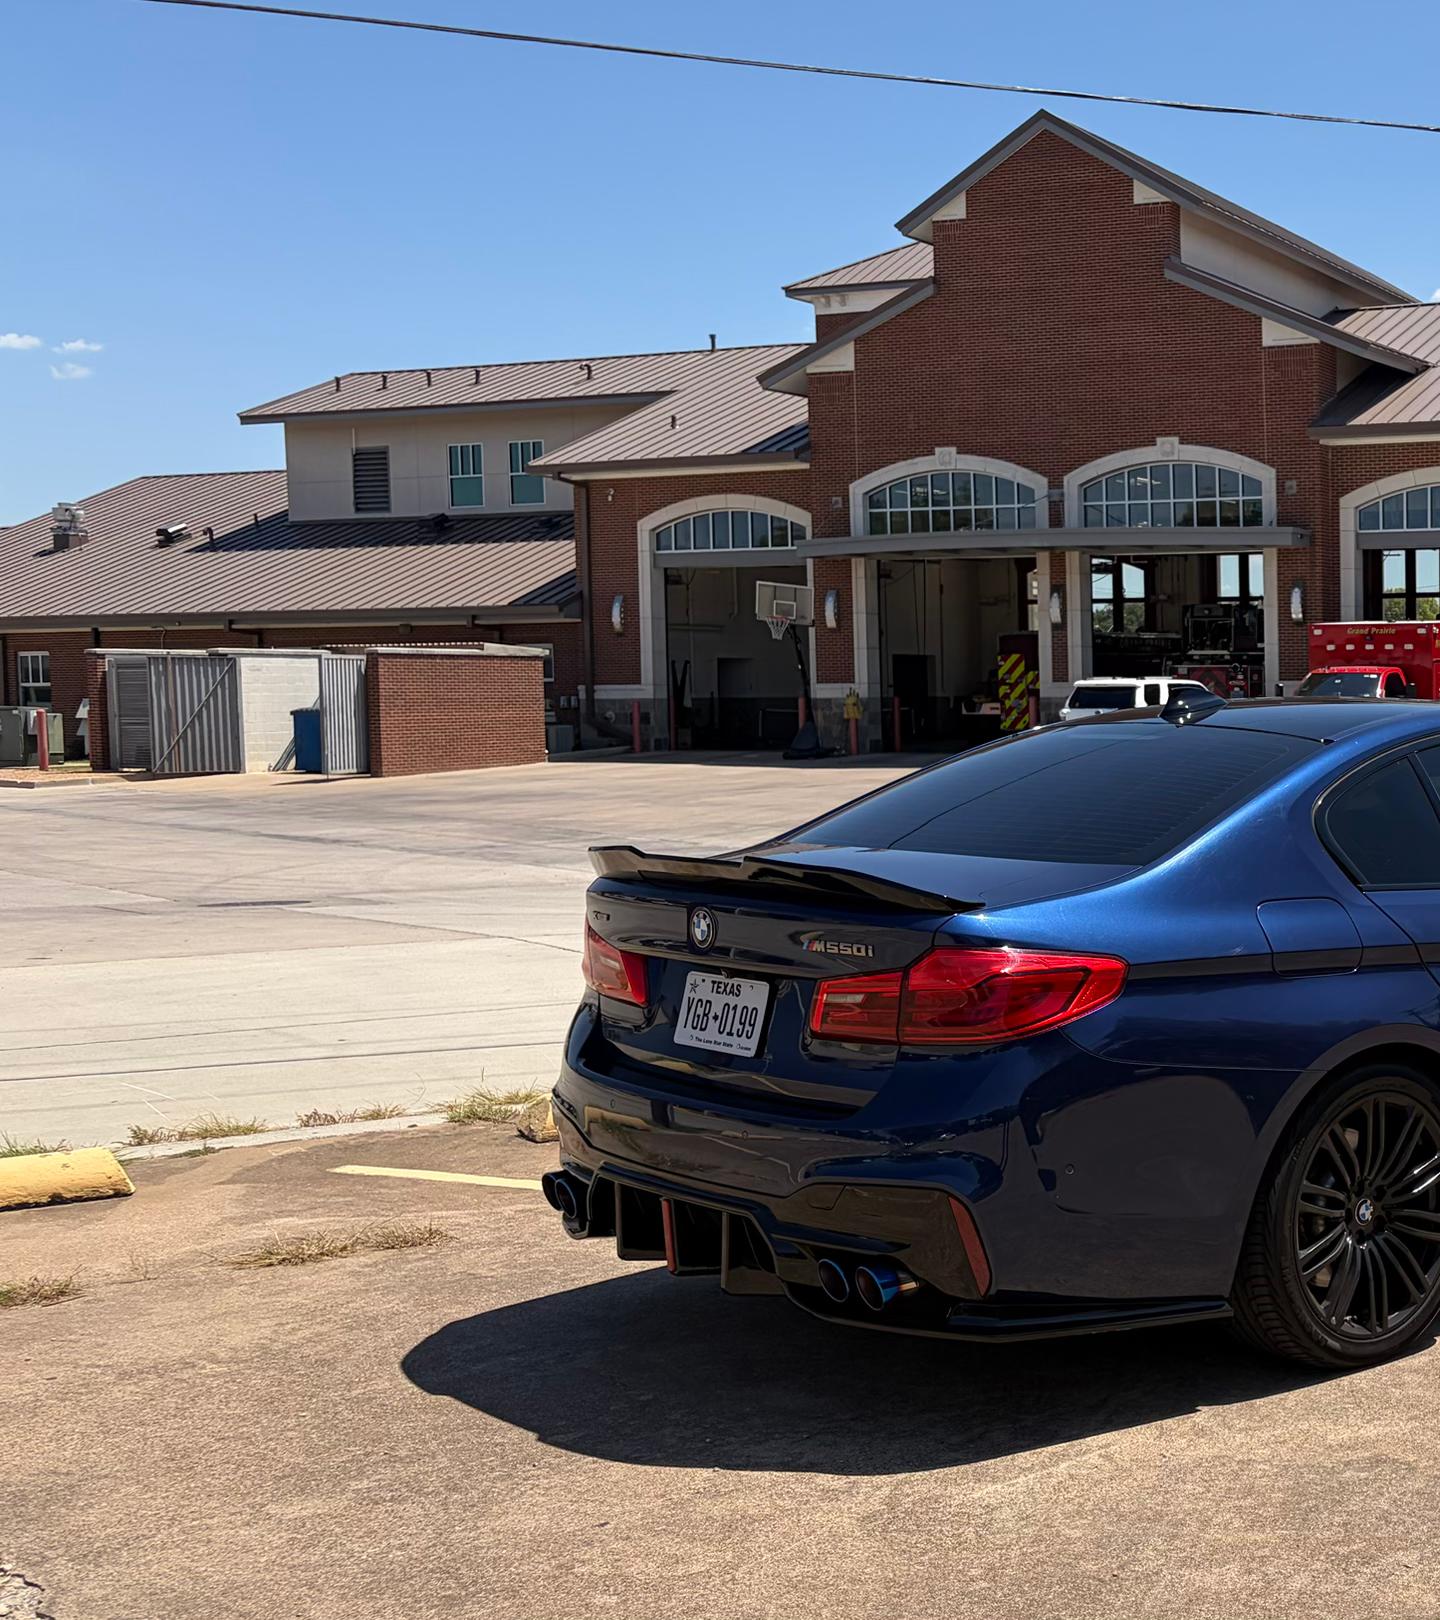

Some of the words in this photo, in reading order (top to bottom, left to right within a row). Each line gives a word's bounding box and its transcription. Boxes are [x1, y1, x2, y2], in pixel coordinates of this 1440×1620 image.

[1346, 627, 1369, 635] Grand
[1371, 627, 1396, 635] Prairie
[813, 940, 873, 957] M550i
[711, 980, 741, 998] TEXAS
[683, 997, 712, 1032] YGB
[718, 1003, 758, 1040] 0199
